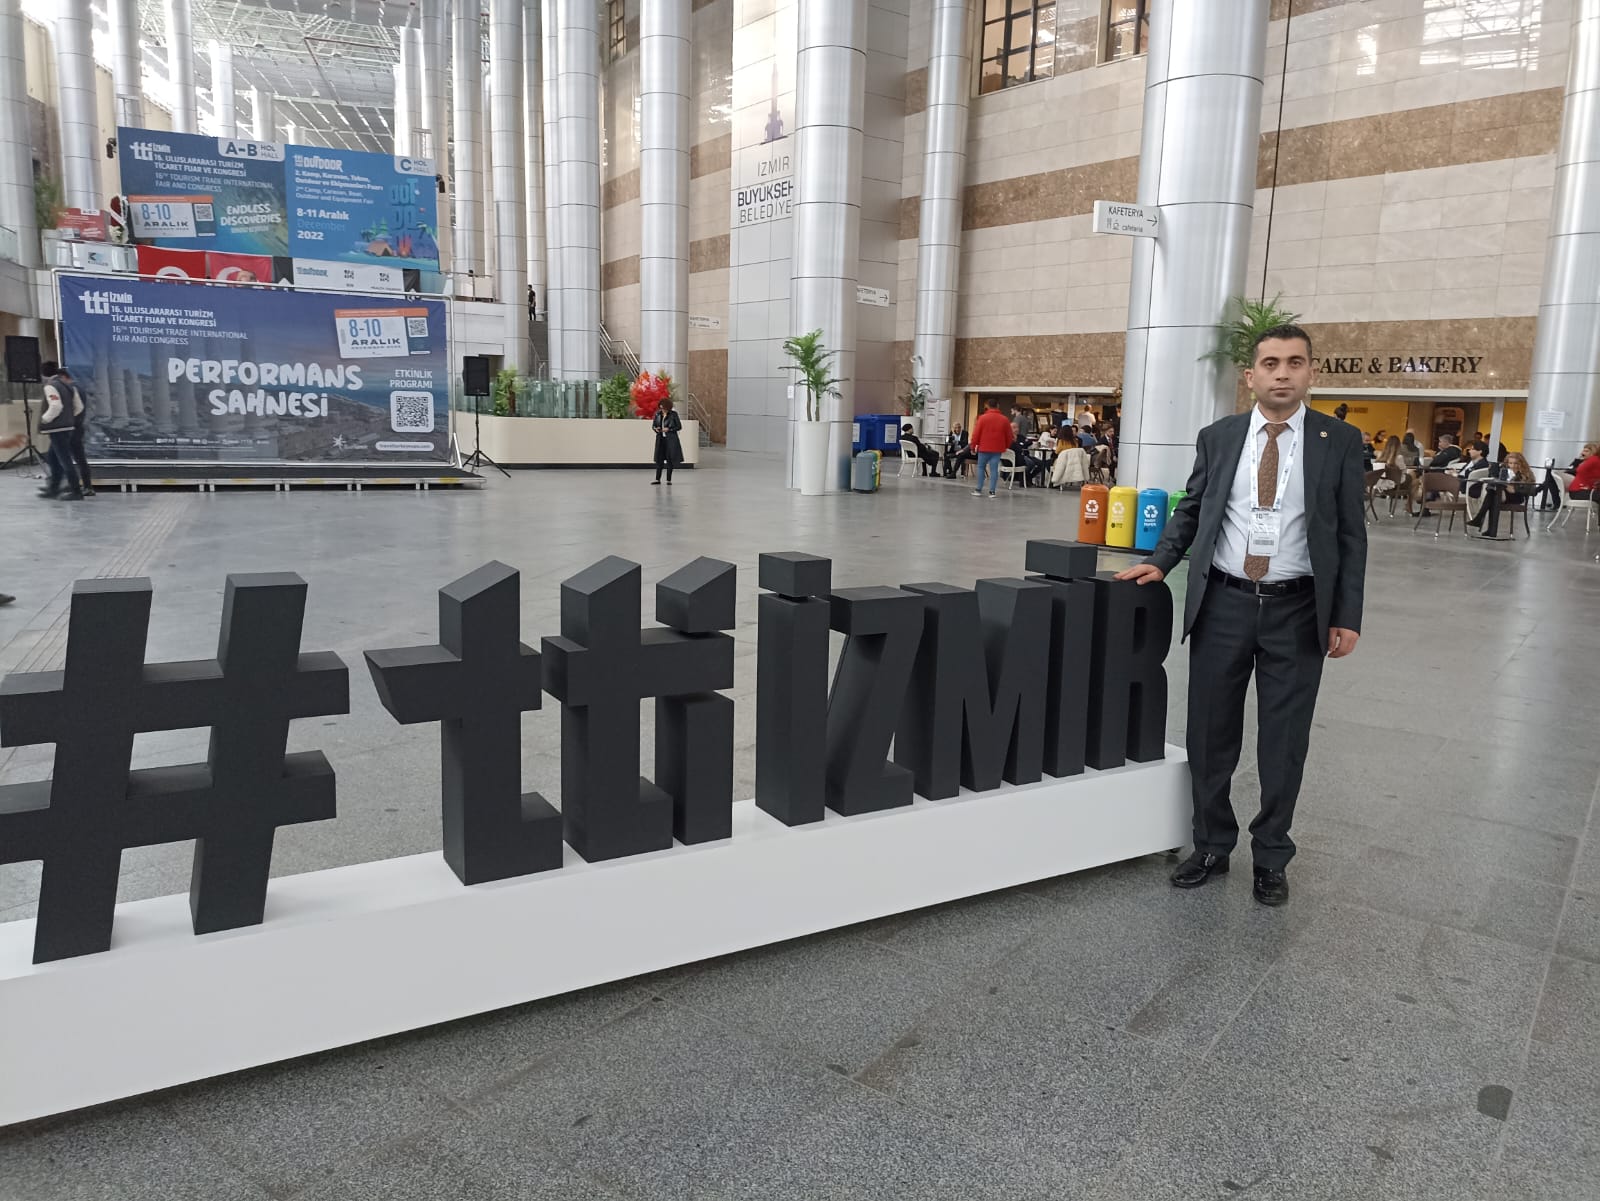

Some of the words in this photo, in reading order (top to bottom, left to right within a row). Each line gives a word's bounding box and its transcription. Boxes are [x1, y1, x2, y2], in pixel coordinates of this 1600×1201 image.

[225, 141, 258, 157] A-B
[260, 144, 276, 152] HOL
[184, 165, 203, 174] FUAR
[400, 158, 411, 171] C
[141, 203, 171, 220] 8-10
[226, 203, 272, 216] ENDLESS
[296, 208, 317, 218] 8-11
[318, 209, 350, 220] Aralık
[1108, 206, 1144, 218] KAFETERYA
[220, 213, 282, 227] DISCOVERIES
[297, 230, 324, 241] 2022
[79, 290, 110, 314] tti
[109, 291, 133, 304] İZMİR
[111, 305, 123, 314] 16.
[124, 306, 183, 317] ULUSLARARASI
[184, 308, 214, 319] TURİZM
[112, 314, 143, 324] TİCARET
[145, 316, 166, 325] FUAR
[167, 318, 177, 326] VE
[178, 318, 217, 328] KONGRESİ
[129, 326, 164, 336] TOURISM
[165, 328, 189, 338] TRADE
[190, 330, 249, 341] INTERNATIONAL
[349, 318, 382, 338] 8-10
[112, 335, 130, 344] FAIR
[131, 335, 148, 344] AND
[149, 336, 189, 346] CONGRESS
[351, 338, 401, 346] ARALIK
[1312, 357, 1363, 374] CAKE
[1368, 357, 1383, 374] &
[1388, 356, 1484, 374] BAKERY
[167, 357, 364, 391] PERFORMANS
[394, 368, 433, 379] ETKİNLİK
[389, 379, 433, 389] PROGRAMI
